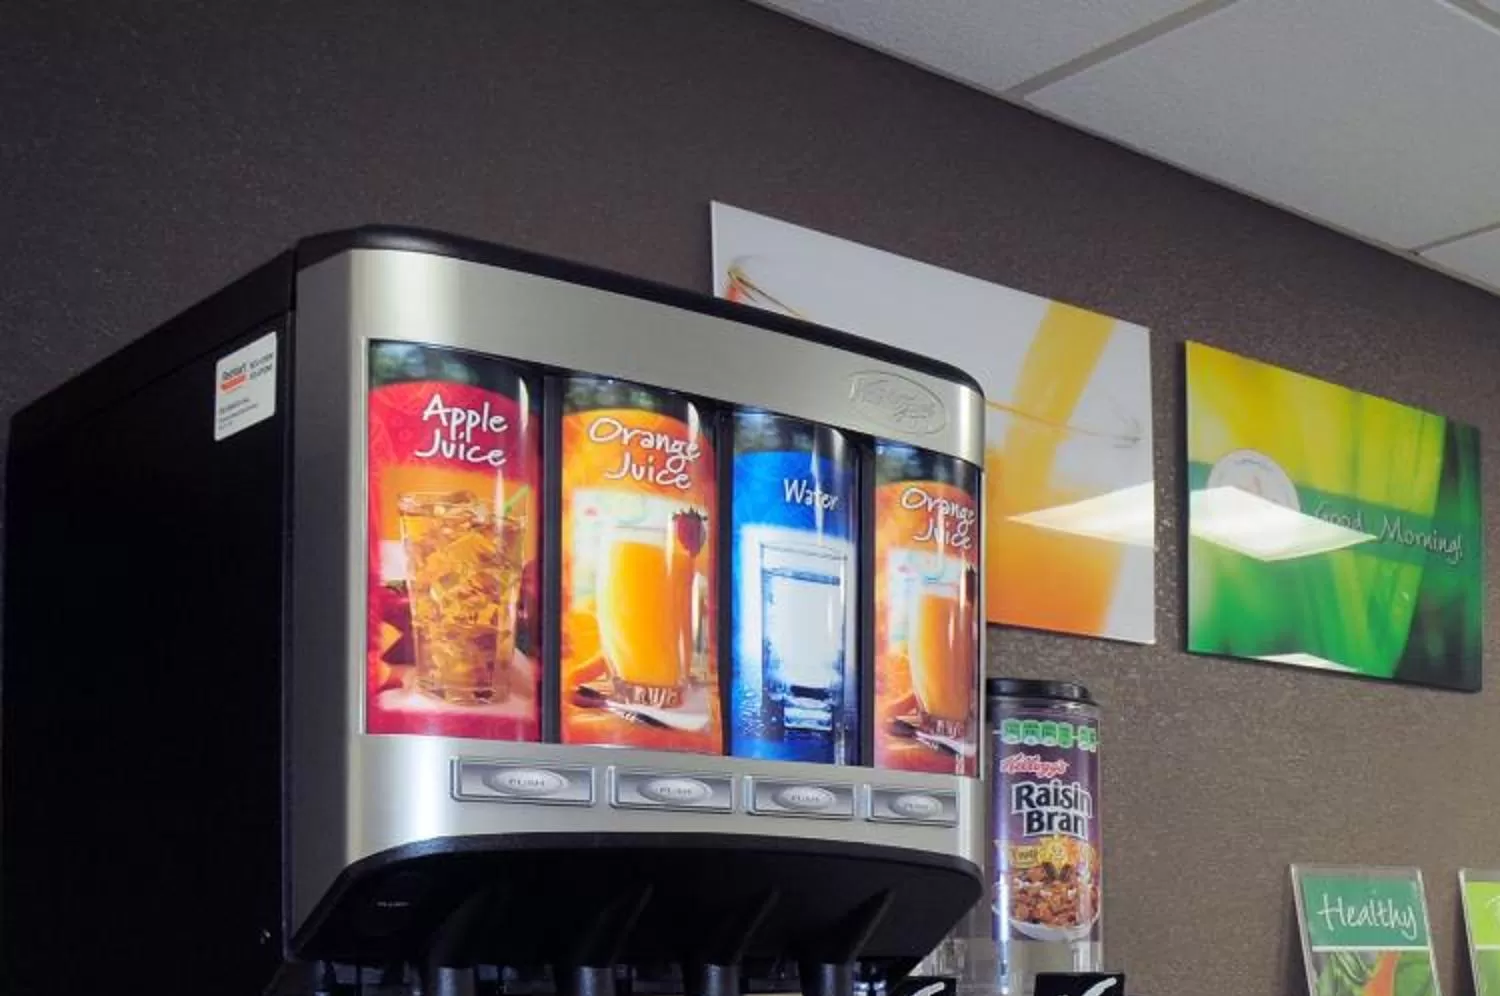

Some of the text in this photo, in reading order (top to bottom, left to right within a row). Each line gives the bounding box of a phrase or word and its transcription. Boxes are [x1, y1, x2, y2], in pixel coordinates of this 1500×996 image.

[421, 394, 508, 443] Apple
[415, 428, 508, 468] Juice
[588, 416, 701, 473] Orange
[604, 451, 693, 490] Juice
[783, 478, 839, 511] Water
[901, 487, 976, 538] Orange
[913, 516, 973, 551] Juice
[1011, 778, 1095, 818] Raisin
[1024, 808, 1089, 841] Bran
[1316, 892, 1418, 941] Healthy
